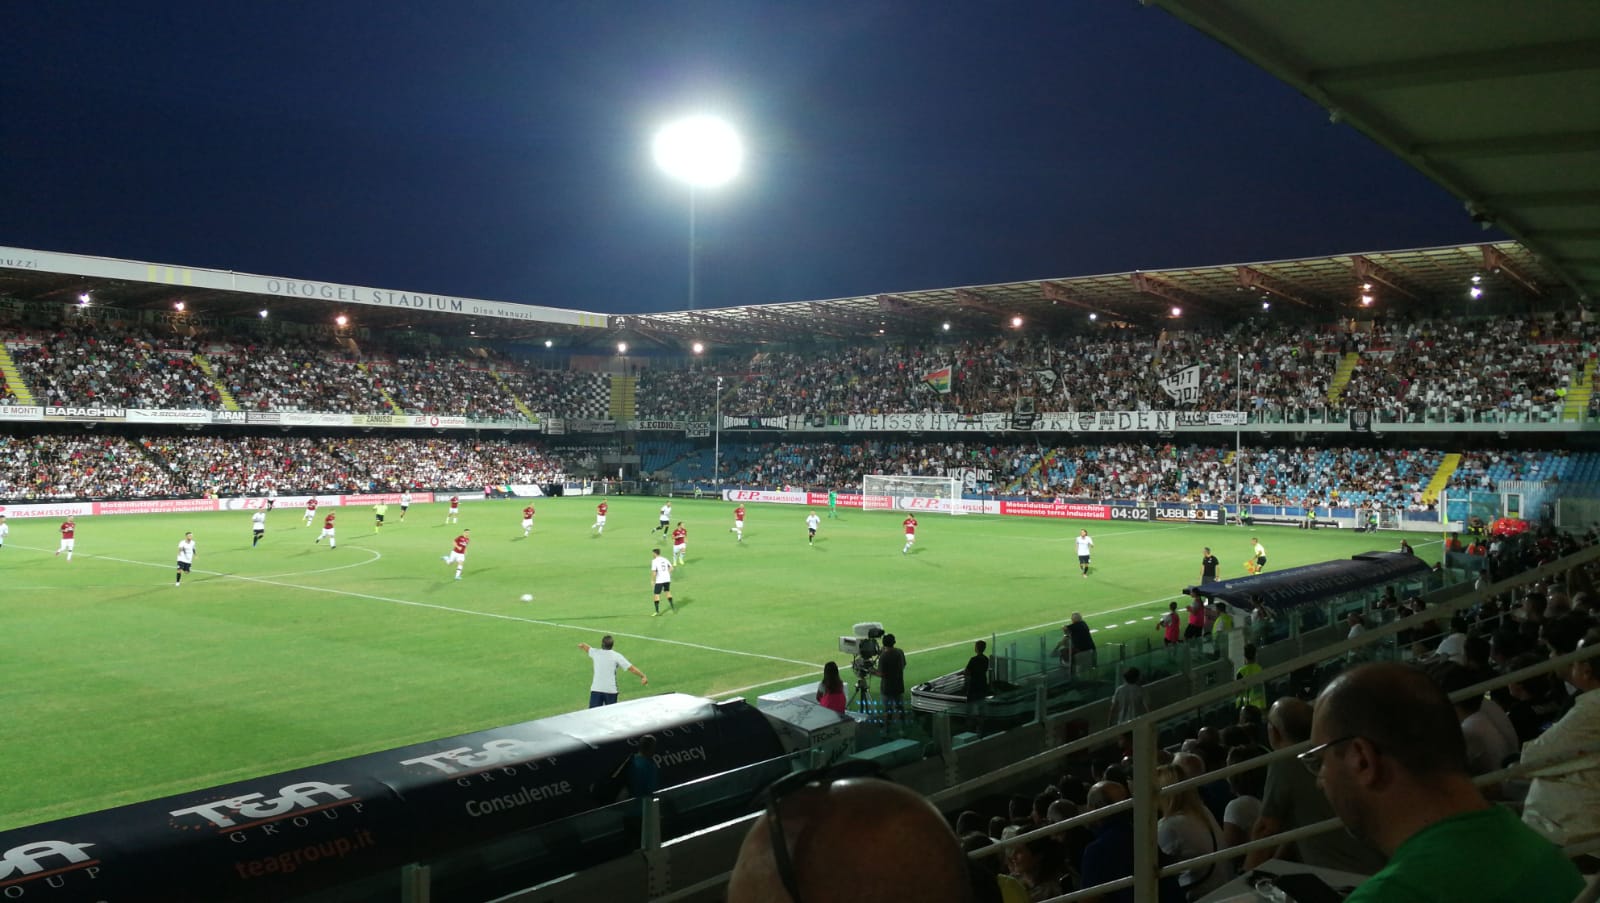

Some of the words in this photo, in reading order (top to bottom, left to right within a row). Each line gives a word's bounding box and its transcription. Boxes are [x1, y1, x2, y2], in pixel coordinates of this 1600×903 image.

[267, 278, 361, 303] OROGEL
[373, 290, 463, 313] STADIUM
[497, 309, 532, 320] Manuzzi
[45, 407, 125, 418] BARAGHINI
[217, 411, 246, 420] ARAN
[366, 415, 393, 424] ZANUSSI
[440, 418, 466, 426] vodafone
[723, 415, 750, 429] BRONX
[761, 415, 788, 429] VIGNE
[11, 508, 82, 518] TRASMISSIONI
[1111, 508, 1148, 519] 04:02
[652, 745, 706, 768] Privacy
[457, 755, 558, 788] GROUP
[465, 779, 573, 817] Consulenze
[229, 801, 364, 844] GROUP
[235, 828, 376, 880] teagroup.it
